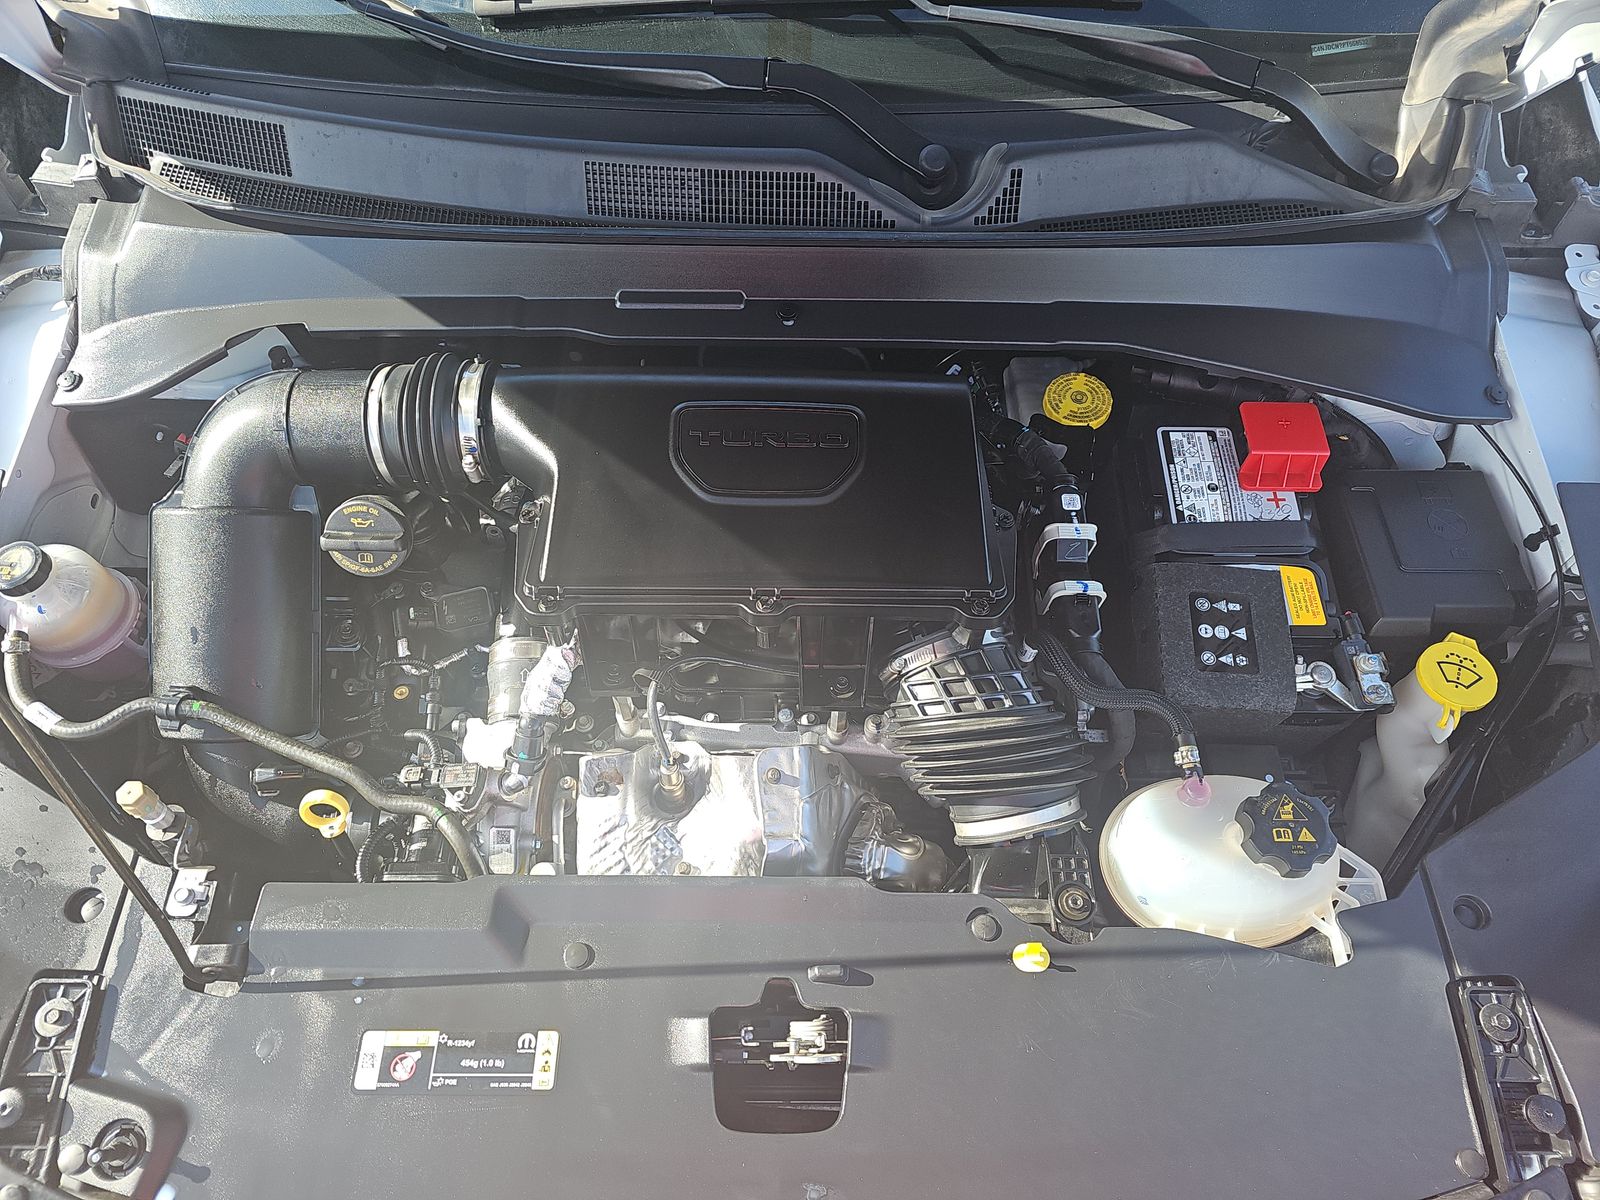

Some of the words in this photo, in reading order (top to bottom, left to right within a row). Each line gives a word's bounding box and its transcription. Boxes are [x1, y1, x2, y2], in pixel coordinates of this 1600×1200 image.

[689, 429, 850, 448] TURBO
[343, 506, 367, 516] ENGINE
[369, 506, 379, 516] OIL
[1286, 575, 1294, 592] BATTERY
[460, 1059, 478, 1068] 454g
[480, 1059, 493, 1068] (1.0
[495, 1059, 505, 1068] lb)
